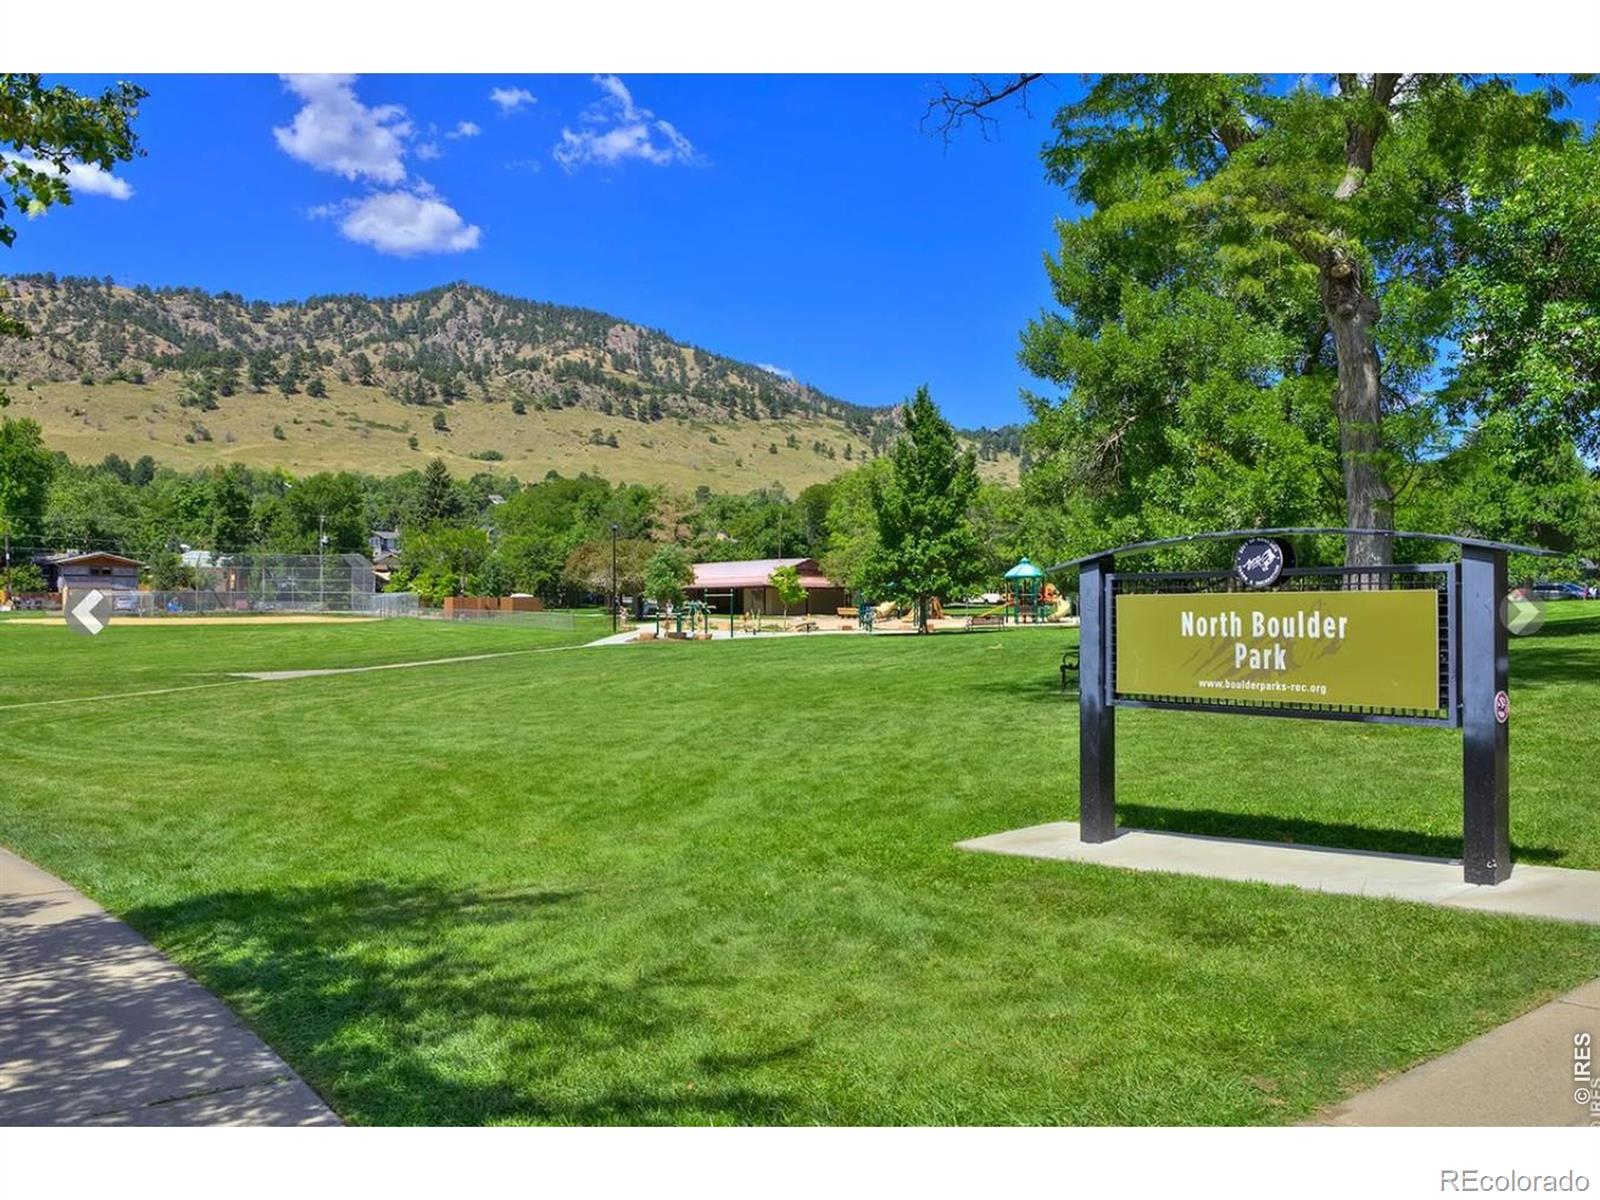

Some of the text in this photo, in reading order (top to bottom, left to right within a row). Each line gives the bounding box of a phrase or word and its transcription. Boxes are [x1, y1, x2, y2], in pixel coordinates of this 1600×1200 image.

[1180, 610, 1348, 639] North Boulder
[1234, 642, 1287, 671] Park
[1198, 678, 1327, 695] www.boulderparks-rec.org
